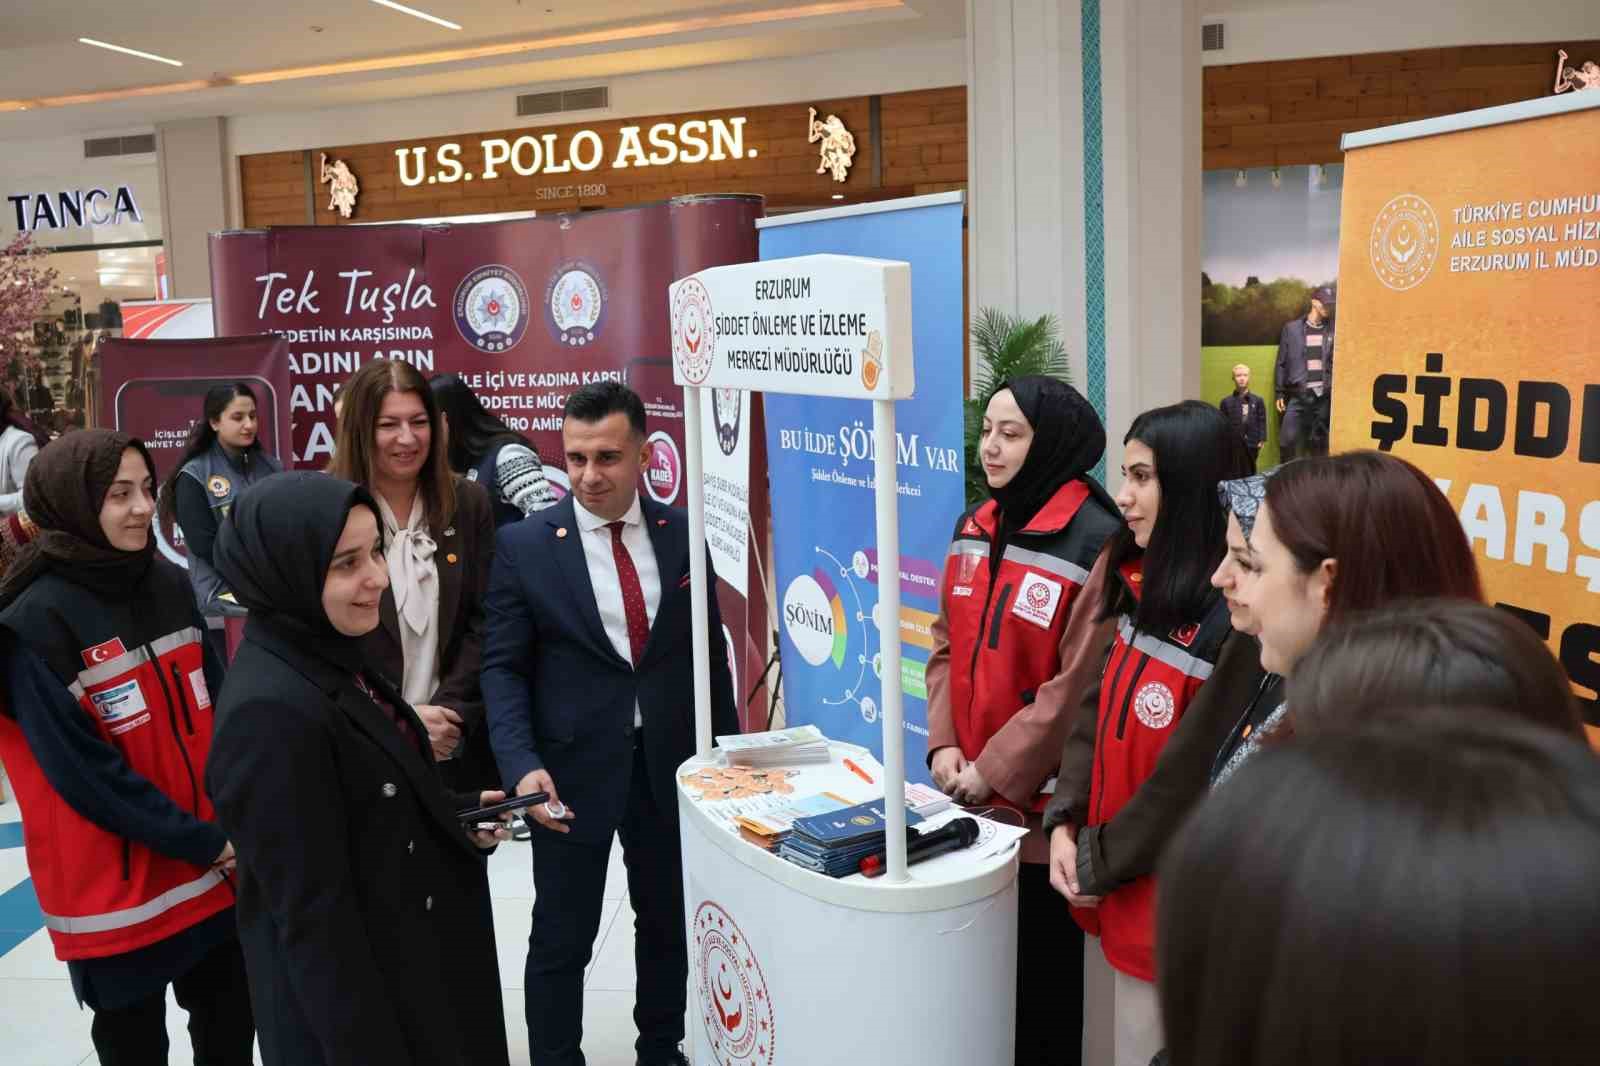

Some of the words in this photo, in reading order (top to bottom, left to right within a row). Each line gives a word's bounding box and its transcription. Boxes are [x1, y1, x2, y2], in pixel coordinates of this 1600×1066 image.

[395, 143, 473, 186] U.S.
[480, 130, 603, 180] POLO
[612, 117, 758, 169] ASSN.
[535, 185, 573, 200] SINCE
[576, 183, 606, 198] 1890
[7, 185, 143, 231] TANCA
[1453, 200, 1523, 225] TÜRKİYE
[1451, 229, 1487, 249] AİLE
[1491, 225, 1560, 247] SOSYAL
[1450, 252, 1530, 272] ERZURUM
[1535, 248, 1550, 269] İL
[256, 270, 320, 319] Tek
[338, 268, 437, 323] Tuşla
[755, 277, 811, 300] ERZURUM
[340, 326, 433, 344] KARŞISINDA
[715, 312, 749, 339] ŞİDDET
[752, 311, 797, 336] ÖNLEME
[801, 314, 816, 336] VE
[819, 309, 867, 336] İZLEME
[728, 346, 772, 371] MERKEZİ
[775, 347, 852, 375] MÜDÜRLÜĞÜ
[486, 371, 505, 391] İÇİ
[507, 374, 526, 387] VE
[528, 372, 580, 387] KADINA
[780, 429, 801, 450] BU
[805, 426, 836, 456] İLDE
[924, 446, 960, 472] VAR
[785, 602, 832, 636] ŞÖNİM
